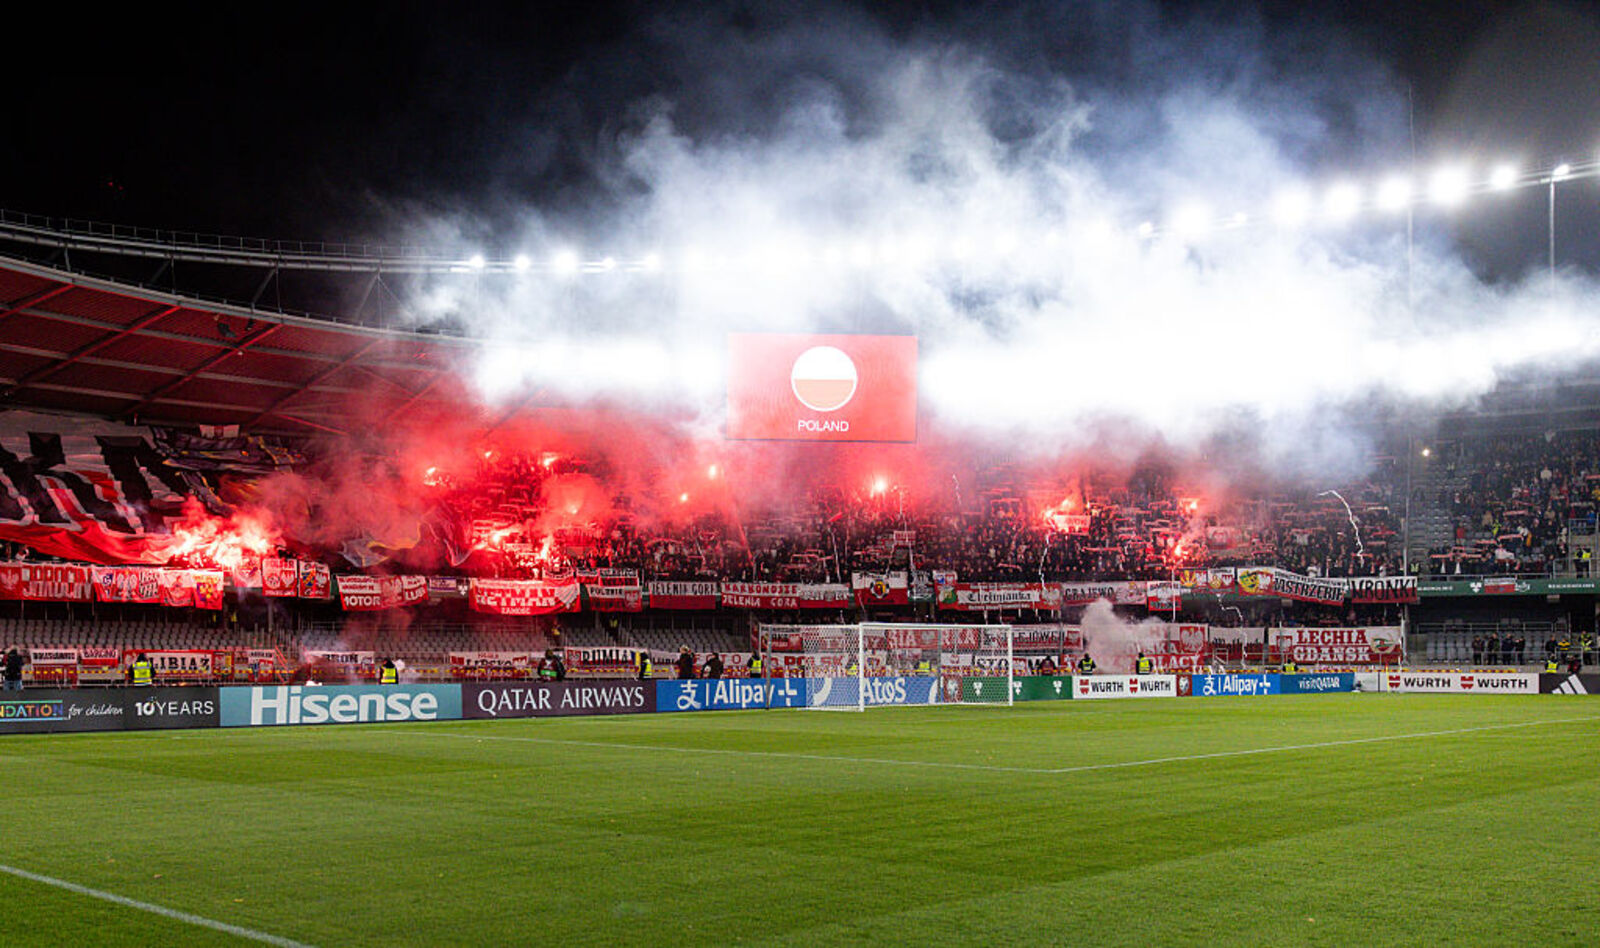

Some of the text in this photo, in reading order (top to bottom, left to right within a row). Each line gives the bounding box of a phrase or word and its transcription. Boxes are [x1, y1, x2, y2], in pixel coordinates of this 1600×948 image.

[798, 420, 849, 432] POLAND
[1351, 579, 1416, 600] WRONKI
[1296, 629, 1368, 645] LECHIA
[582, 650, 629, 666] RUMIA
[1223, 674, 1259, 694] Alipay
[1404, 677, 1451, 689] WÜRTH
[1477, 679, 1529, 689] WÜRTH
[478, 686, 645, 716] QATAR AIRWAYS
[714, 679, 775, 709] Alipay
[68, 704, 84, 720] for
[85, 703, 123, 716] children
[251, 686, 439, 726] Hisense
